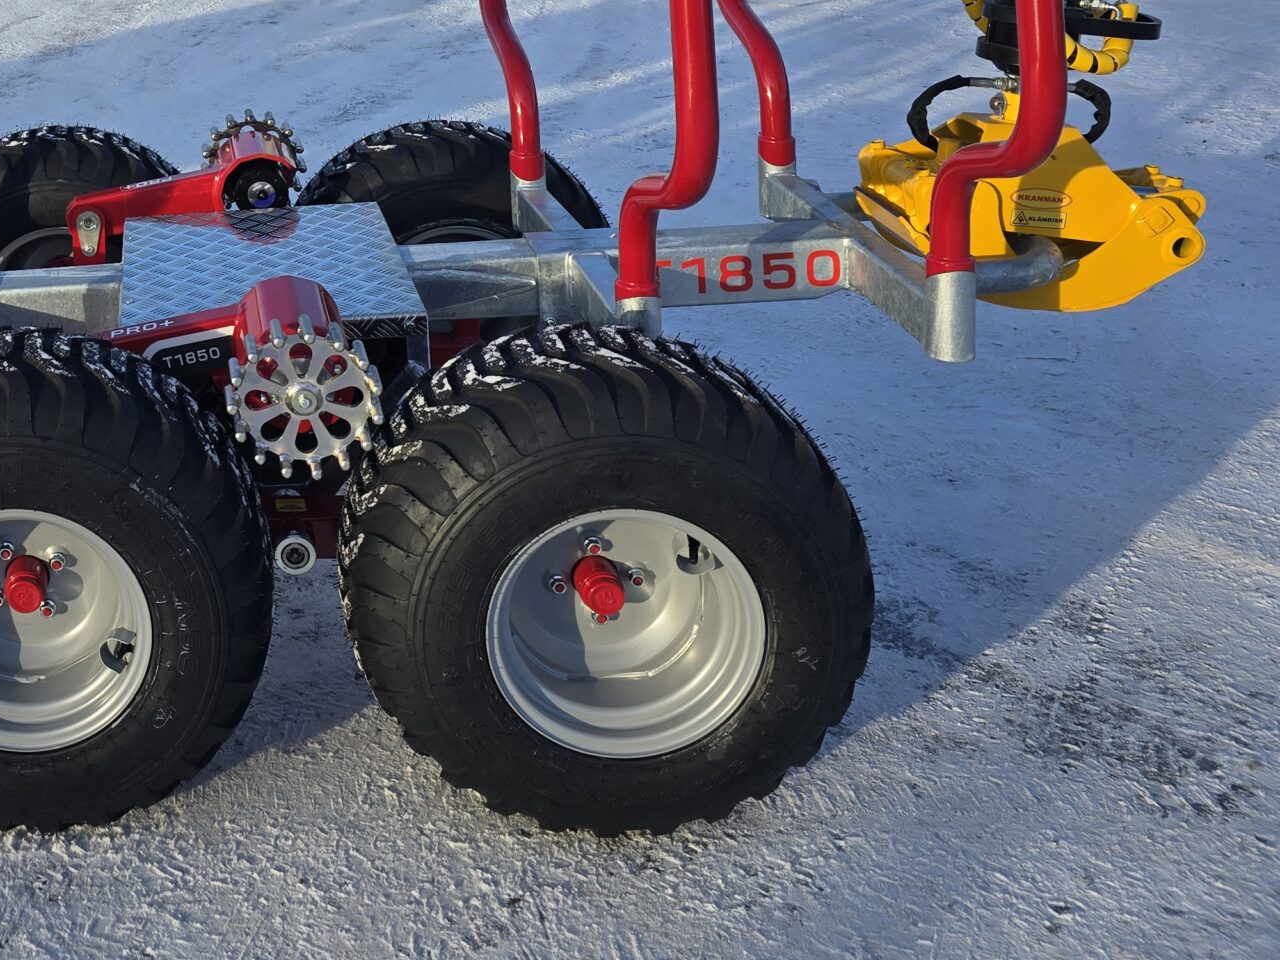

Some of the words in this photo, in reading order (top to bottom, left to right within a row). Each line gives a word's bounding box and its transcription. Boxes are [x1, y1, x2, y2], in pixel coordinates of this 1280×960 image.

[1017, 194, 1064, 203] KRANMAN
[111, 320, 174, 339] PRO+
[162, 346, 221, 369] T1850
